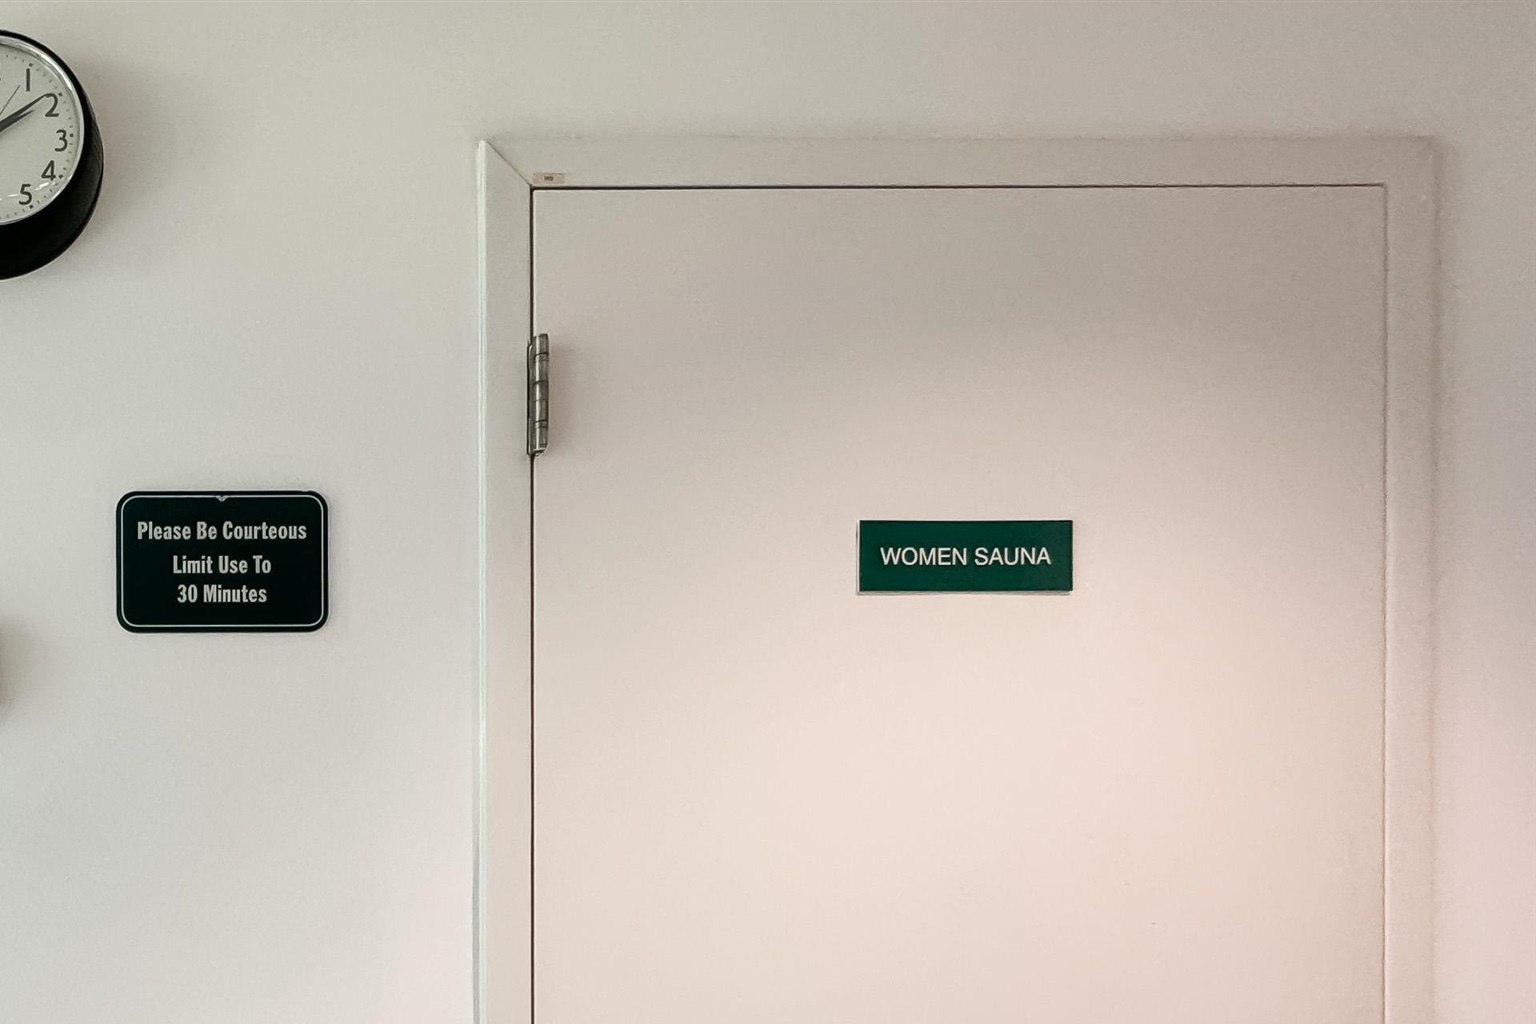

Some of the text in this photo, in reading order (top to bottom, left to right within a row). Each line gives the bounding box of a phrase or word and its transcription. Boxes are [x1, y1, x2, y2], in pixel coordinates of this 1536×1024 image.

[25, 68, 31, 92] 1
[44, 93, 59, 117] 2
[55, 129, 68, 152] 3
[41, 160, 57, 181] 4
[18, 183, 33, 205] 5
[137, 521, 307, 540] Please Be Courteous
[172, 554, 272, 574] Limit Use To
[880, 547, 1052, 566] WOMEN SAUNA
[177, 584, 267, 603] 30 Minutes
